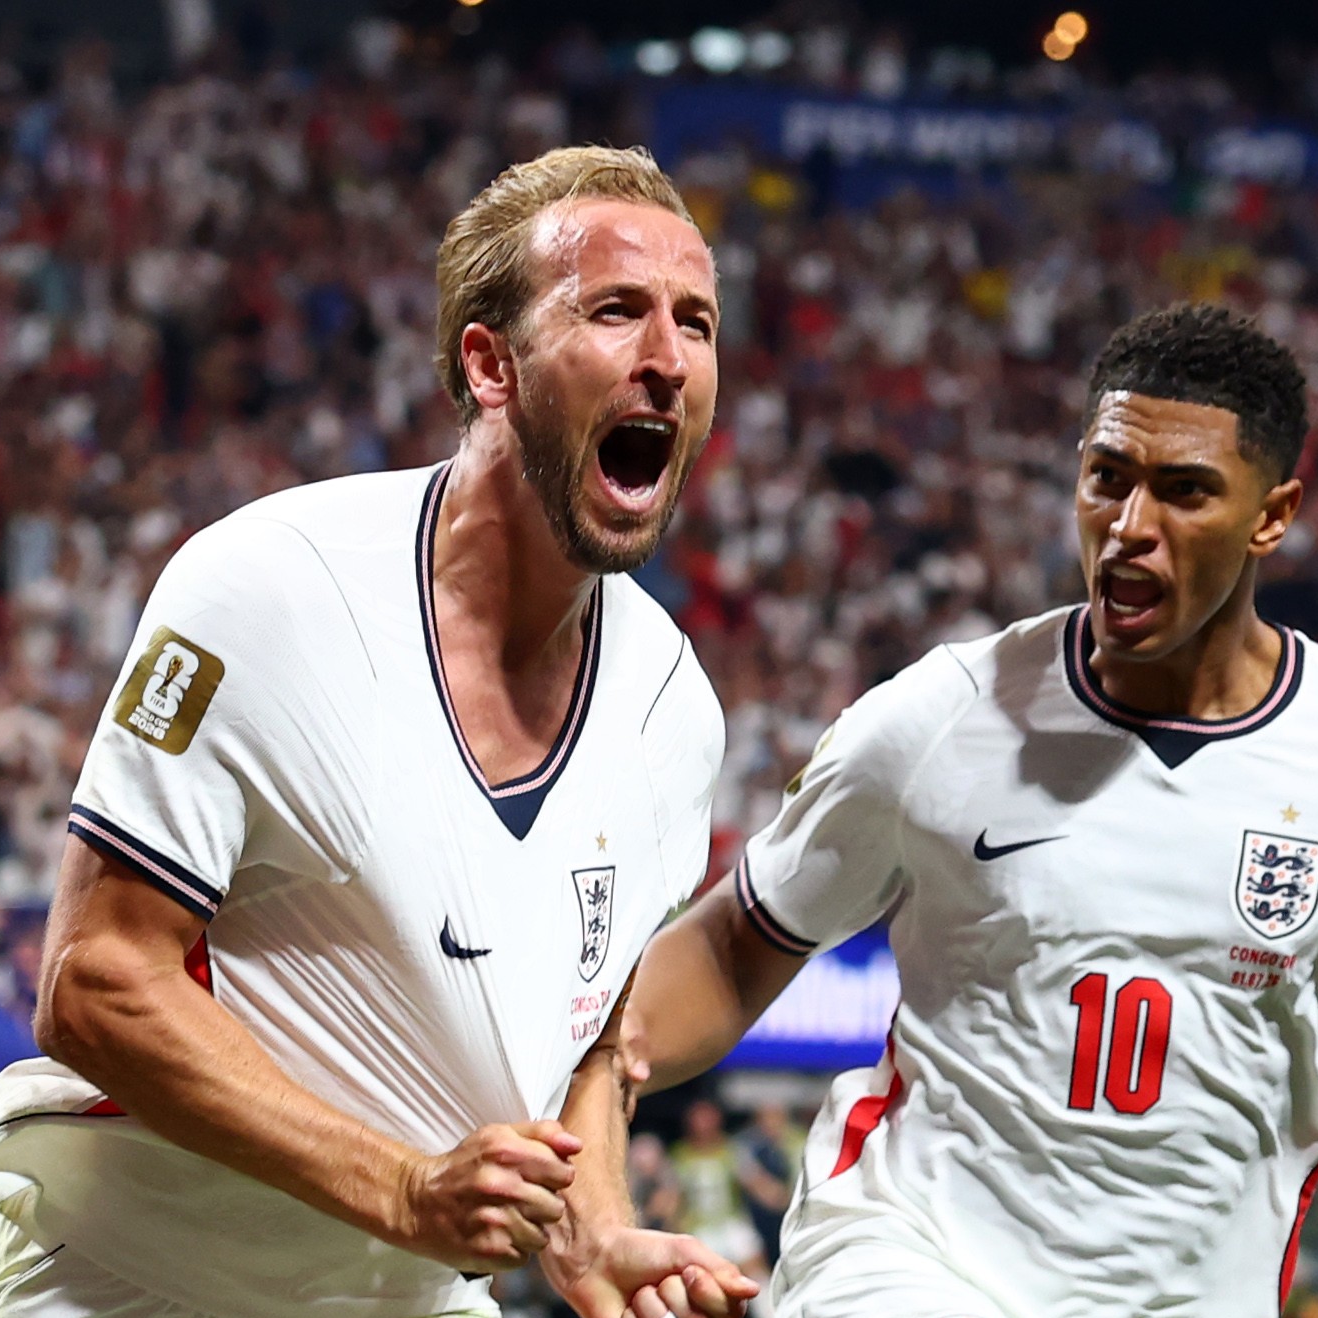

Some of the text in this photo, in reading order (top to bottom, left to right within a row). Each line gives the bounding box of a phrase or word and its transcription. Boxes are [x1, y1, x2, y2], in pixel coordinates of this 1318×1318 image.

[149, 695, 166, 710] FIFA
[128, 712, 166, 740] 2026
[154, 715, 170, 730] CUP
[1229, 945, 1279, 966] CONGO
[1067, 971, 1173, 1115] 10
